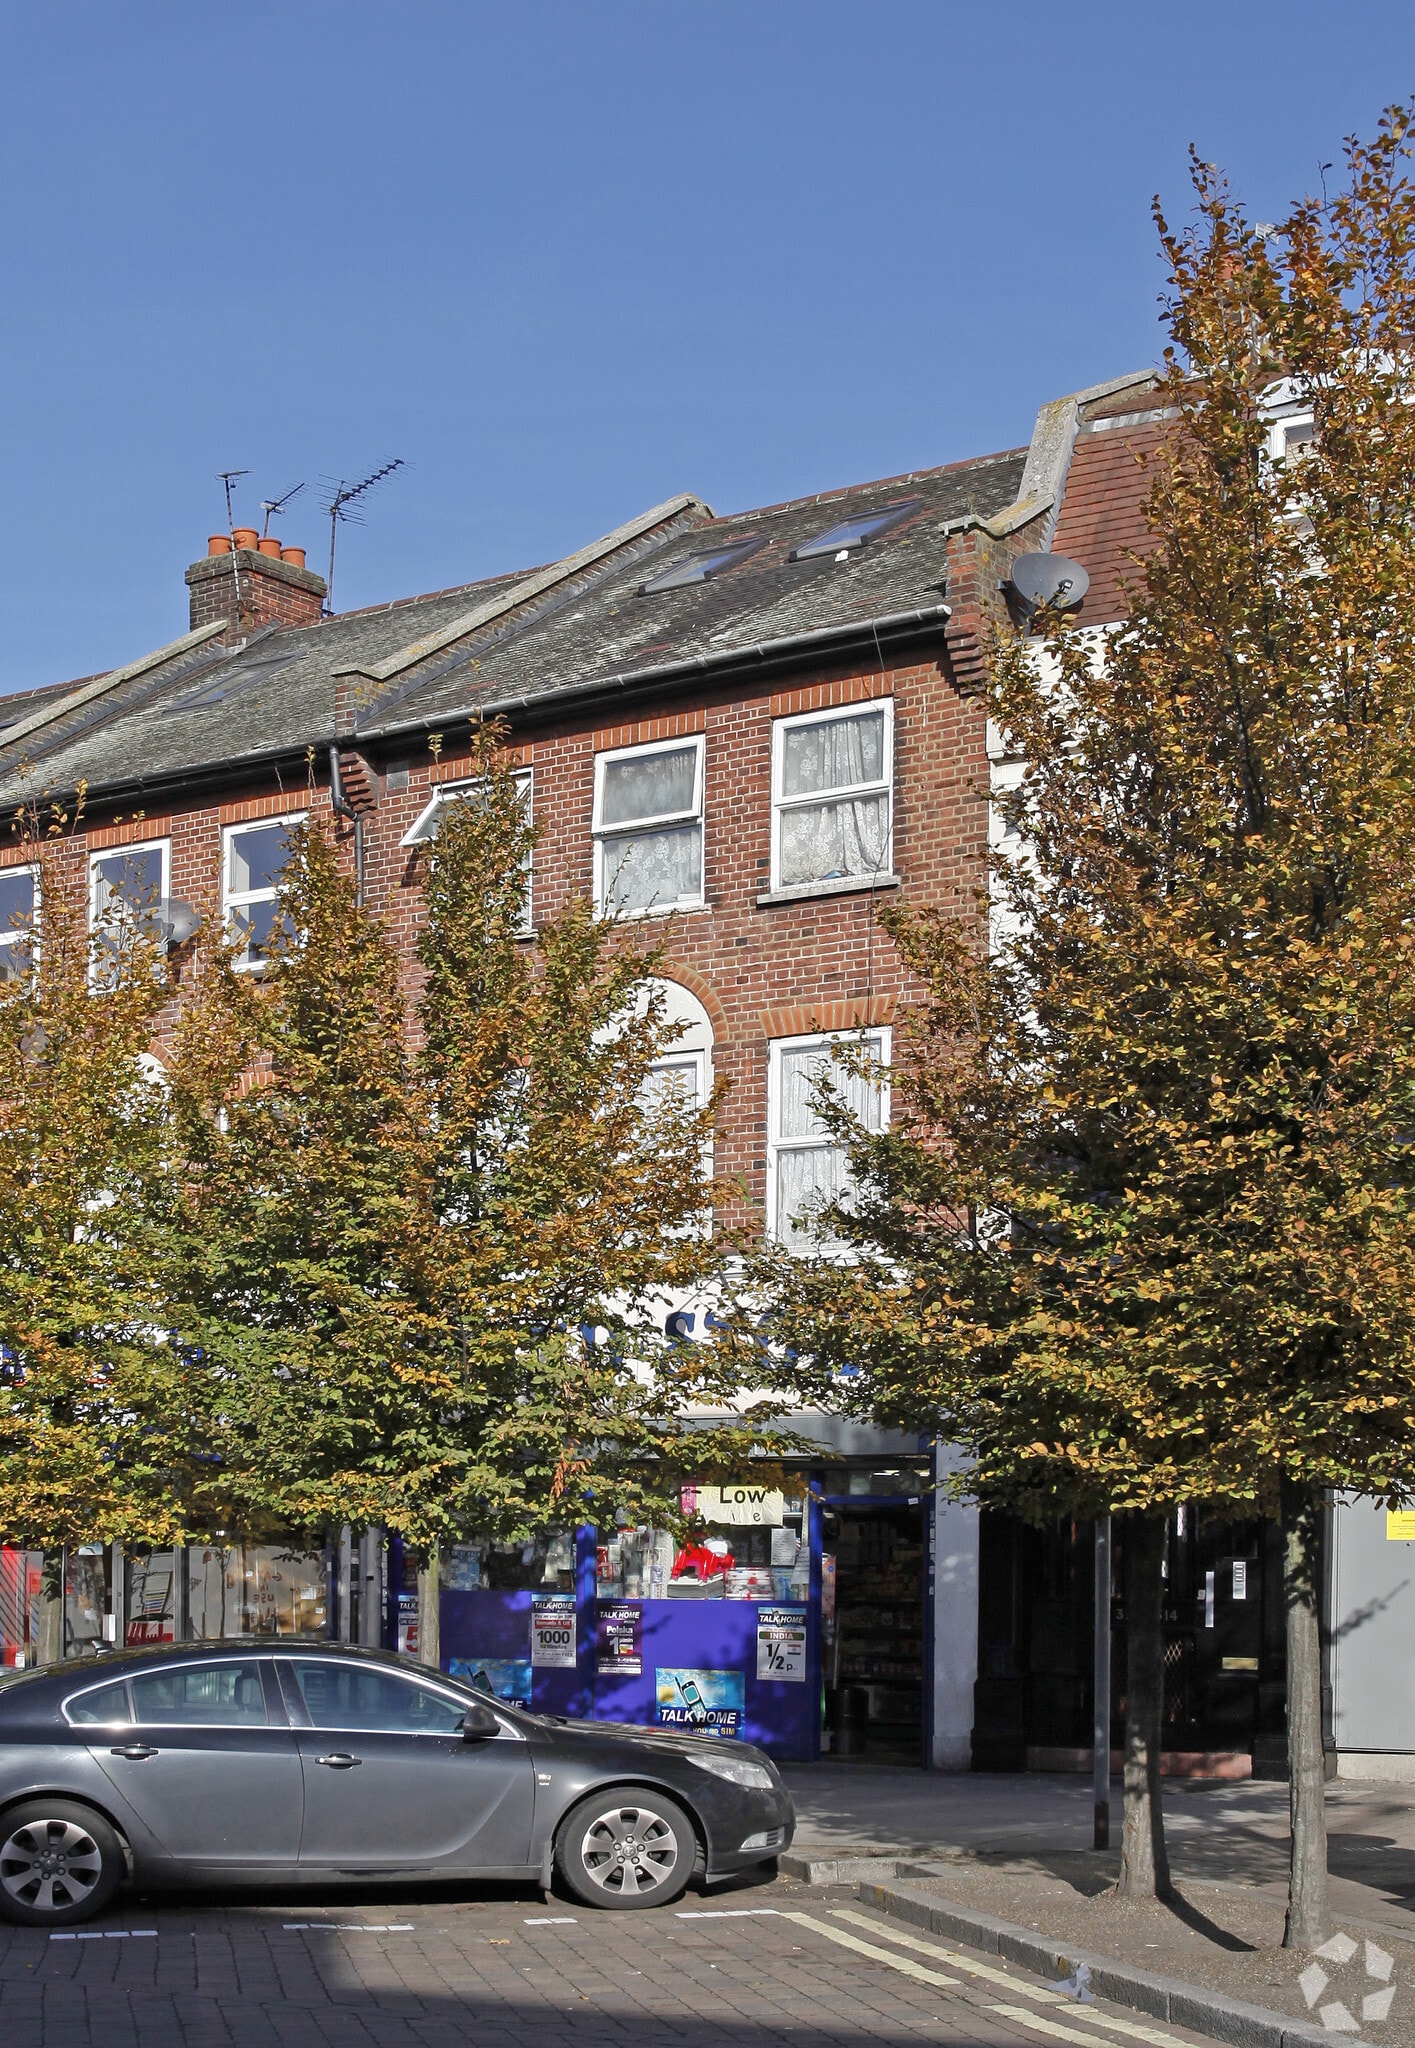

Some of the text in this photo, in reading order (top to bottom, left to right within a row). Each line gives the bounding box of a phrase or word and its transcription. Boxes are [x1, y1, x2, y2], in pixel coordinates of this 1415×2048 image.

[720, 1486, 767, 1504] Low
[399, 1602, 416, 1610] TALK
[552, 1602, 573, 1610] HOME
[599, 1611, 641, 1619] TALK HOME
[759, 1615, 804, 1624] TALK HOME
[606, 1625, 633, 1634] Polska
[537, 1630, 570, 1644] 1000
[769, 1632, 794, 1640] INDIA
[609, 1636, 619, 1655] 1
[661, 1709, 737, 1724] TALK HOME
[720, 1727, 735, 1736] SIM
